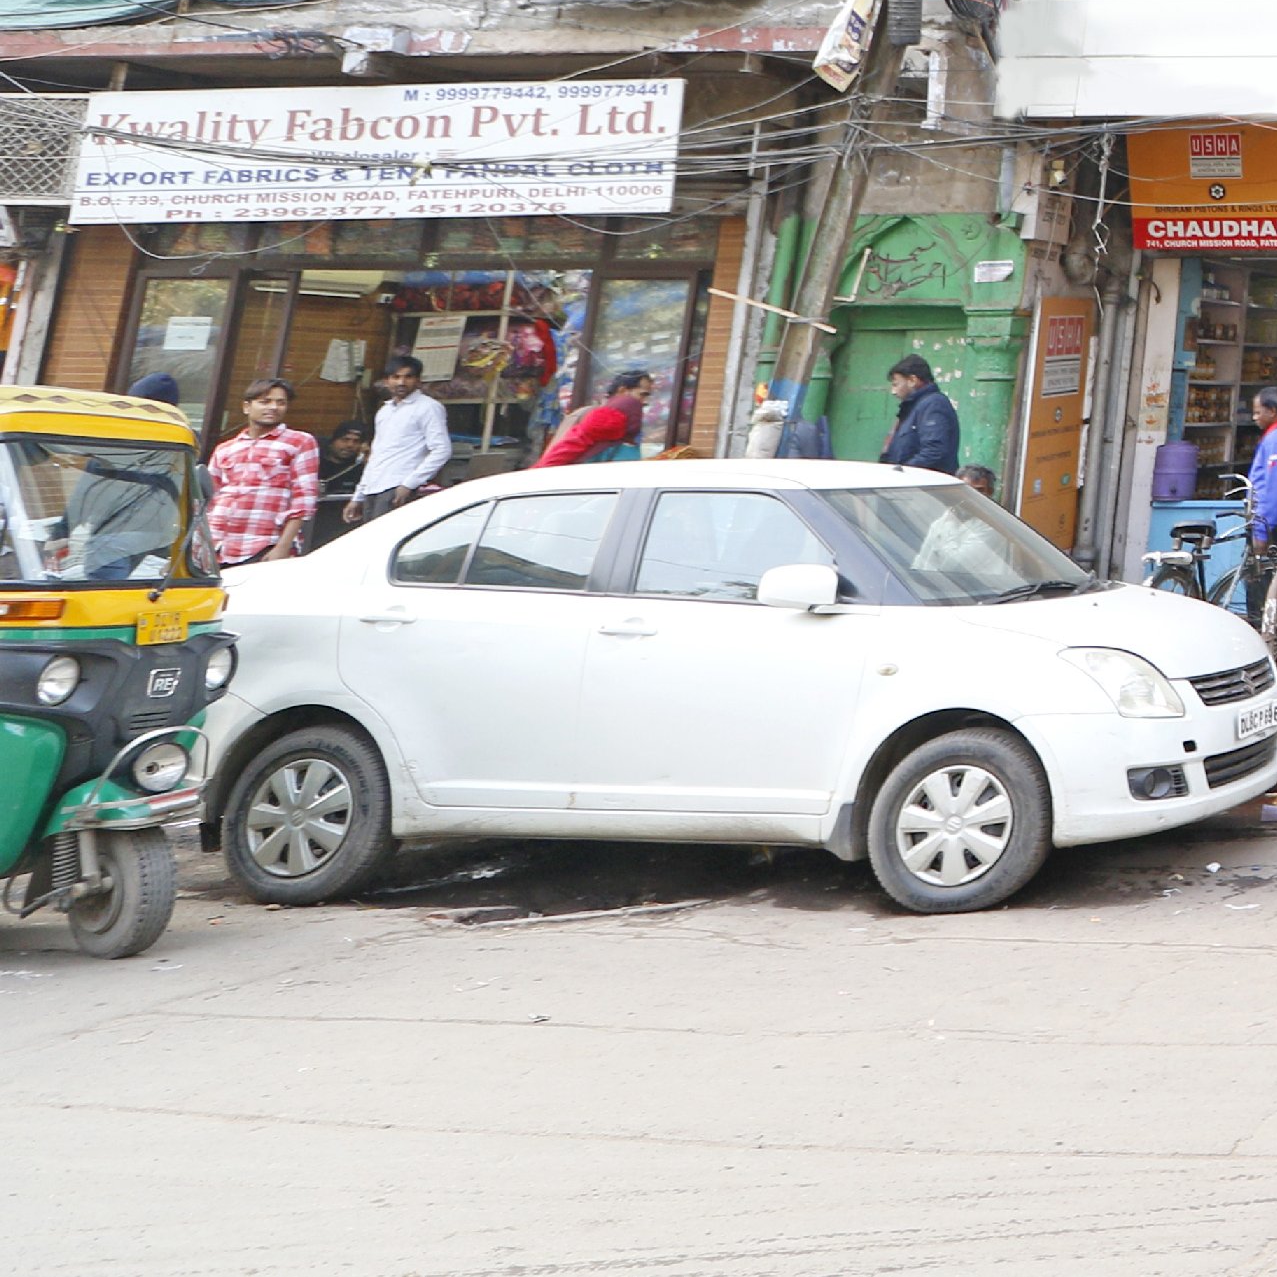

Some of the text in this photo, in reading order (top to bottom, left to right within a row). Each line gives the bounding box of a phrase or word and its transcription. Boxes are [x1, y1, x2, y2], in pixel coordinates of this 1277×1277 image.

[557, 84, 669, 99] 9999779441
[94, 101, 666, 149] Kwality Fabcon Pvt. Ltd.
[1191, 138, 1239, 154] USHA
[85, 170, 194, 187] EXPORT
[202, 167, 328, 185] FABRICS
[364, 164, 433, 180] TEN
[170, 193, 249, 206] CHURCH
[256, 191, 337, 204] MISSION
[343, 189, 400, 202] ROAD,
[1164, 240, 1198, 248] CHURCH
[1199, 240, 1233, 248] MISSION
[1234, 240, 1259, 249] ROAD,
[153, 677, 174, 692] RE
